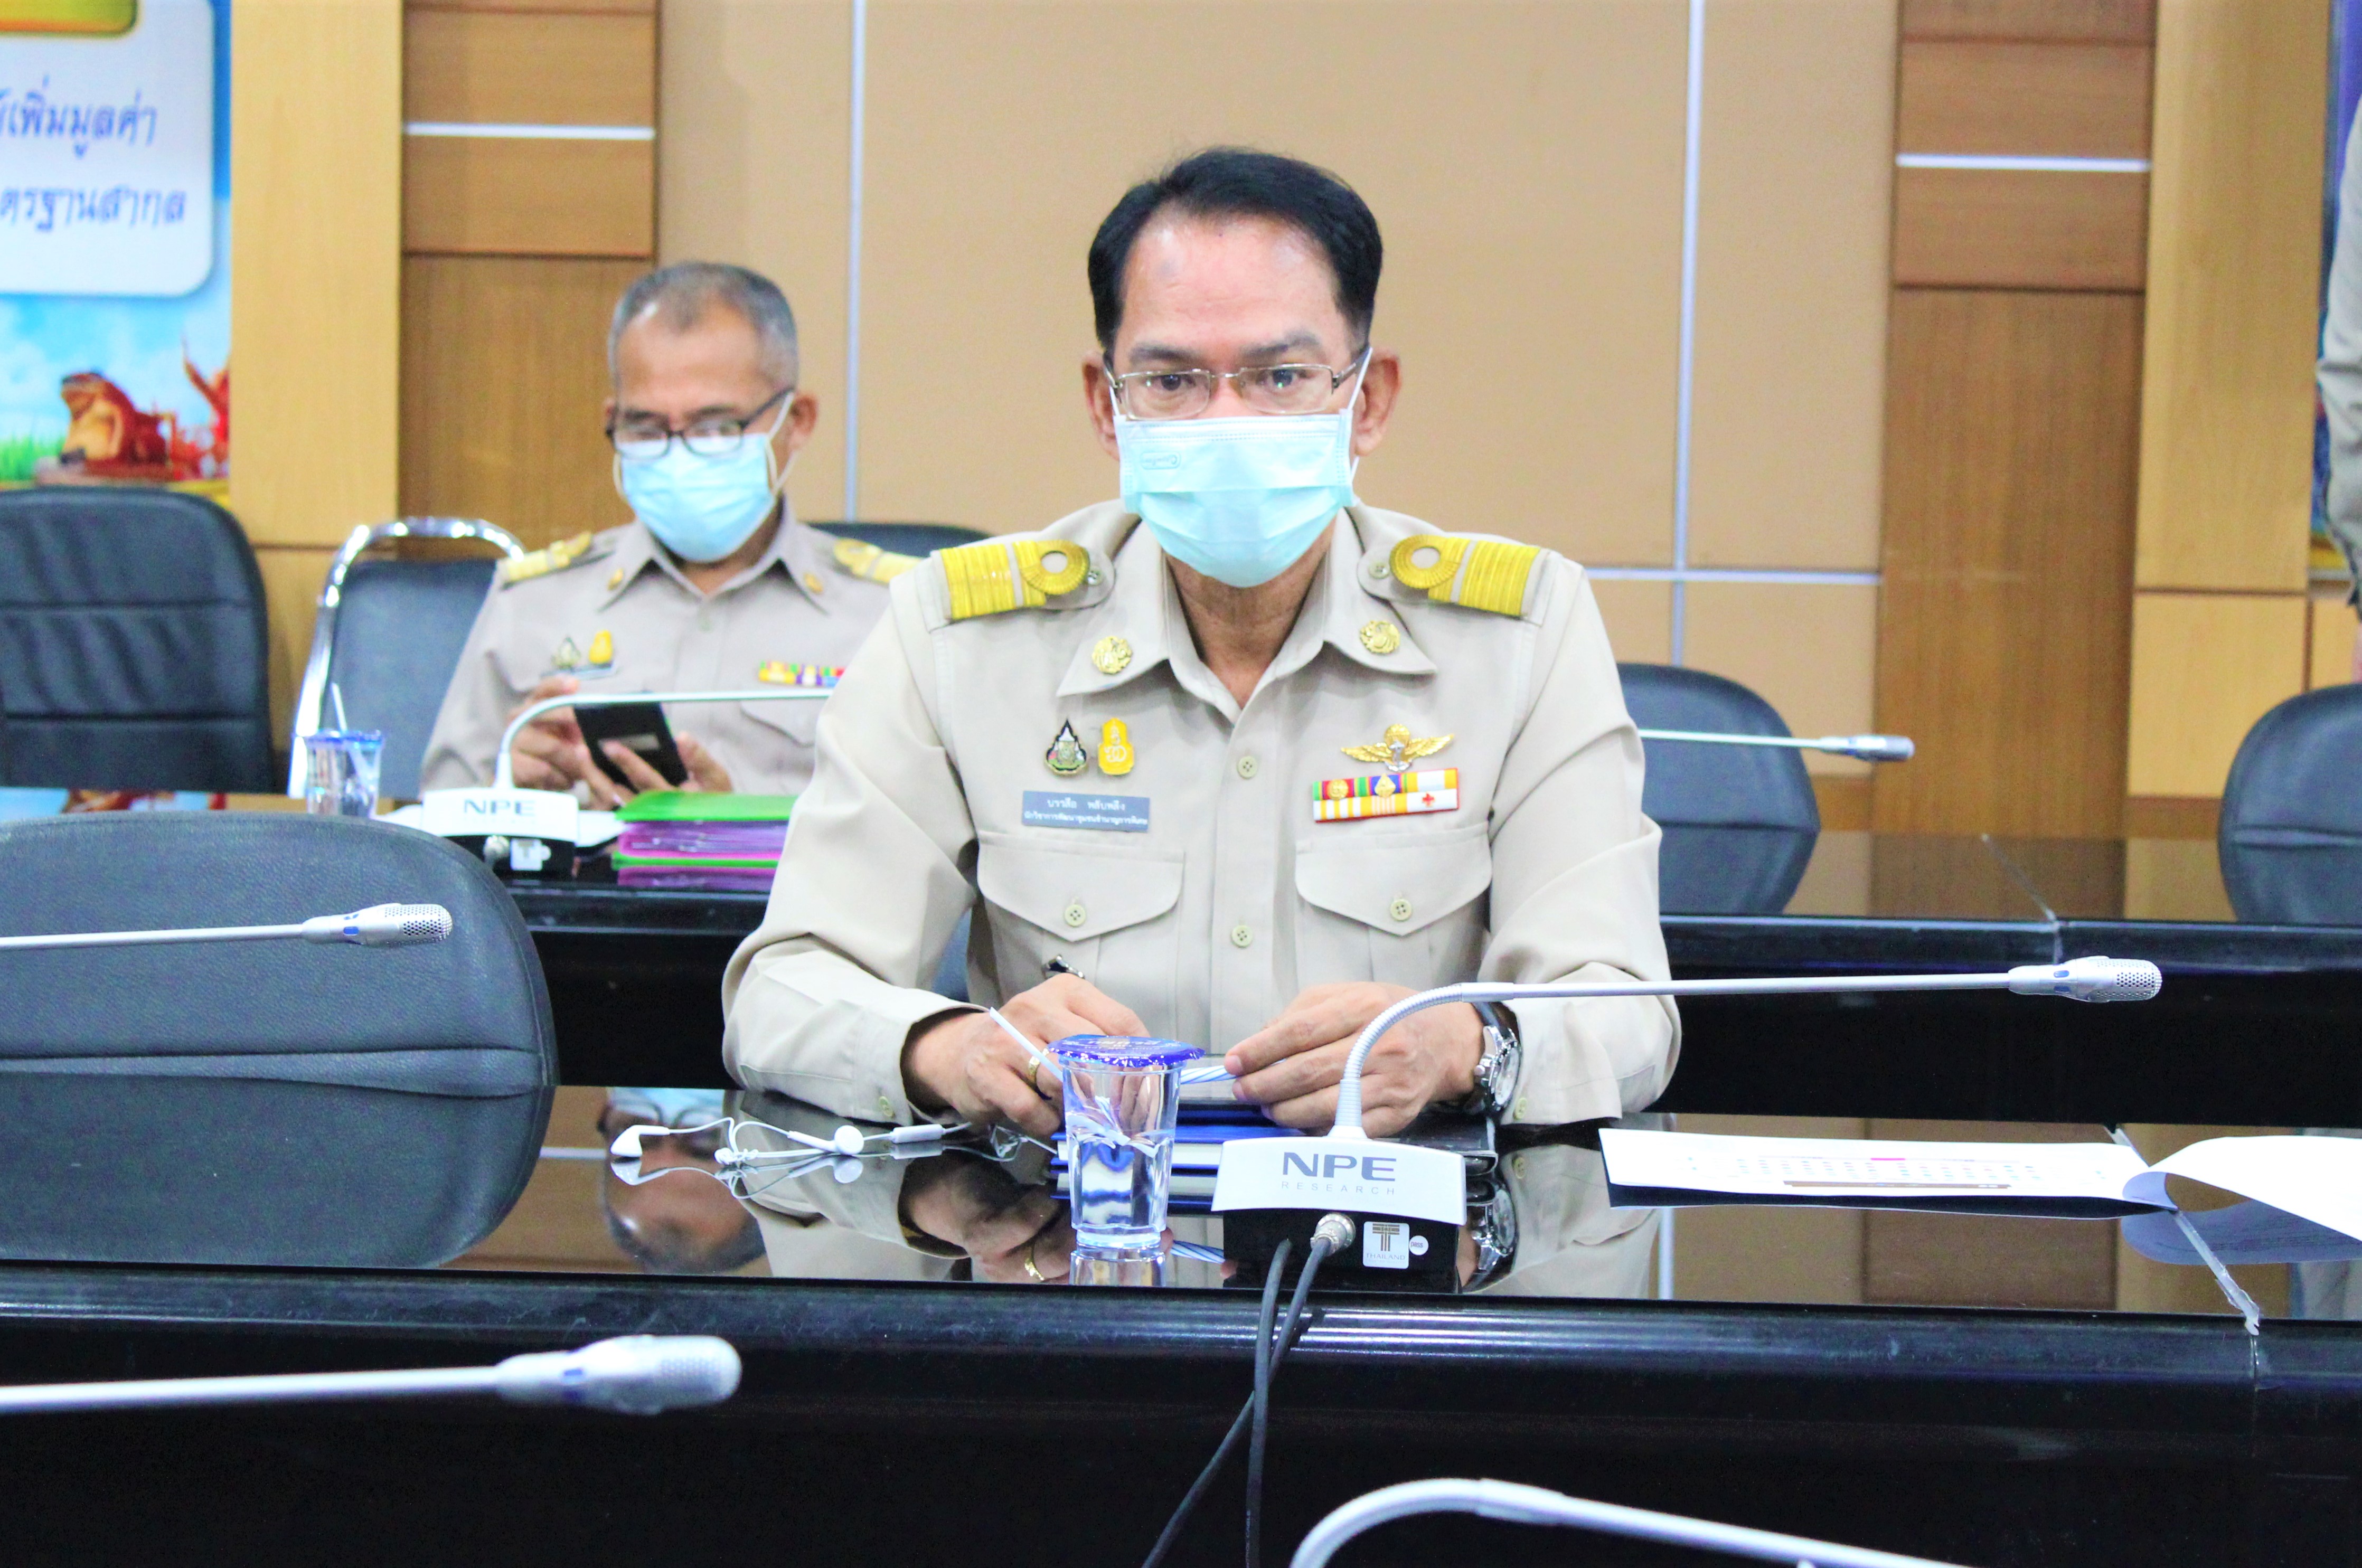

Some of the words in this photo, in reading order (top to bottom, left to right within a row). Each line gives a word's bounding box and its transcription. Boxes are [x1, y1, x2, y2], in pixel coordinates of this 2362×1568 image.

[463, 798, 535, 817] NPE
[1283, 1152, 1397, 1182] NPE
[1281, 1180, 1395, 1196] RESEARCH
